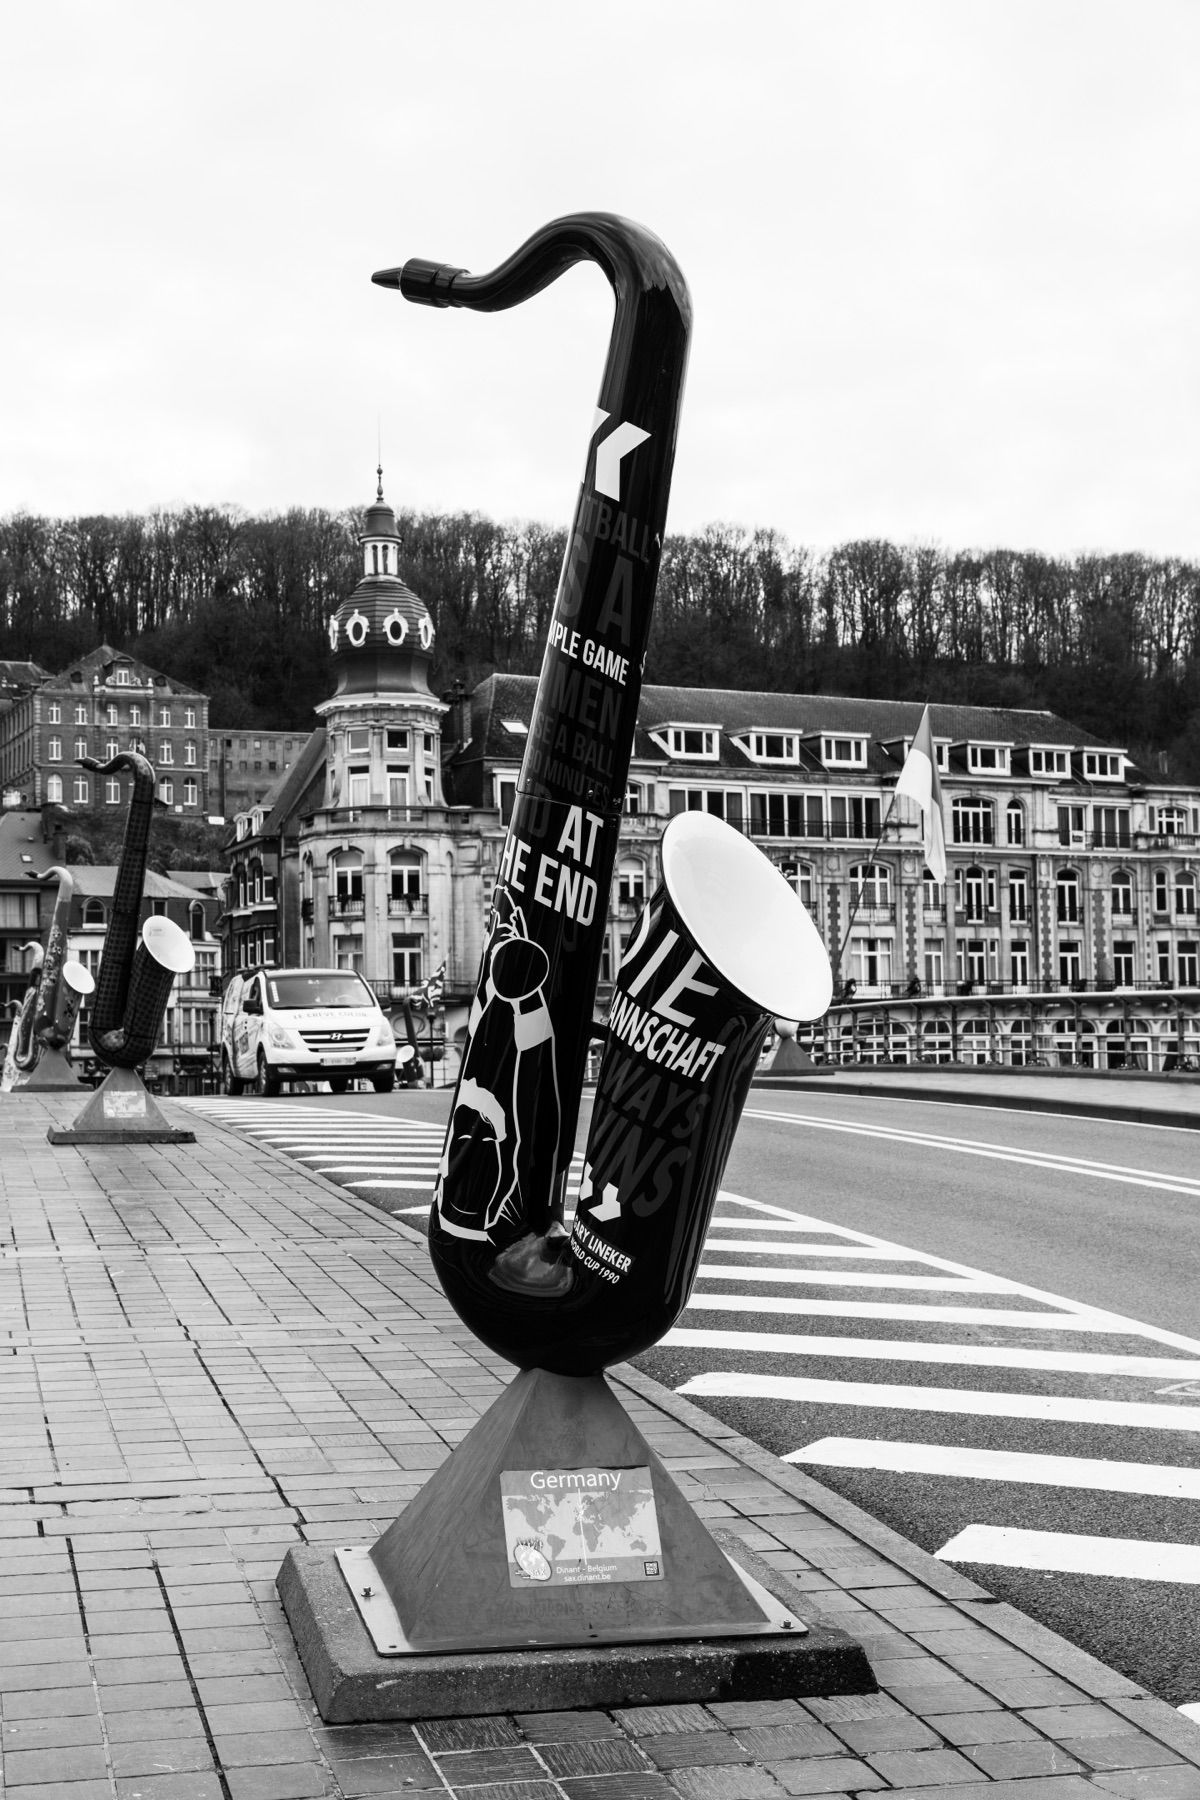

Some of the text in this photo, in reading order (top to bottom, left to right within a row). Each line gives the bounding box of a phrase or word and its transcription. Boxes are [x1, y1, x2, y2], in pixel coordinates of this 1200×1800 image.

[595, 553, 633, 648] A
[582, 638, 630, 686] GAME
[550, 660, 623, 741] MEN
[554, 723, 568, 754] A
[571, 730, 613, 778] BALL
[543, 755, 610, 812] MINUTES
[556, 804, 605, 868] AT
[533, 853, 598, 927] END
[583, 1256, 601, 1271] CUP
[598, 1266, 621, 1285] 1990
[587, 1234, 632, 1273] LINEKER
[530, 1471, 622, 1491] Germany
[556, 1566, 581, 1575] Dinant
[587, 1564, 618, 1575] Belgium
[564, 1573, 611, 1582] sax.dinant.be
